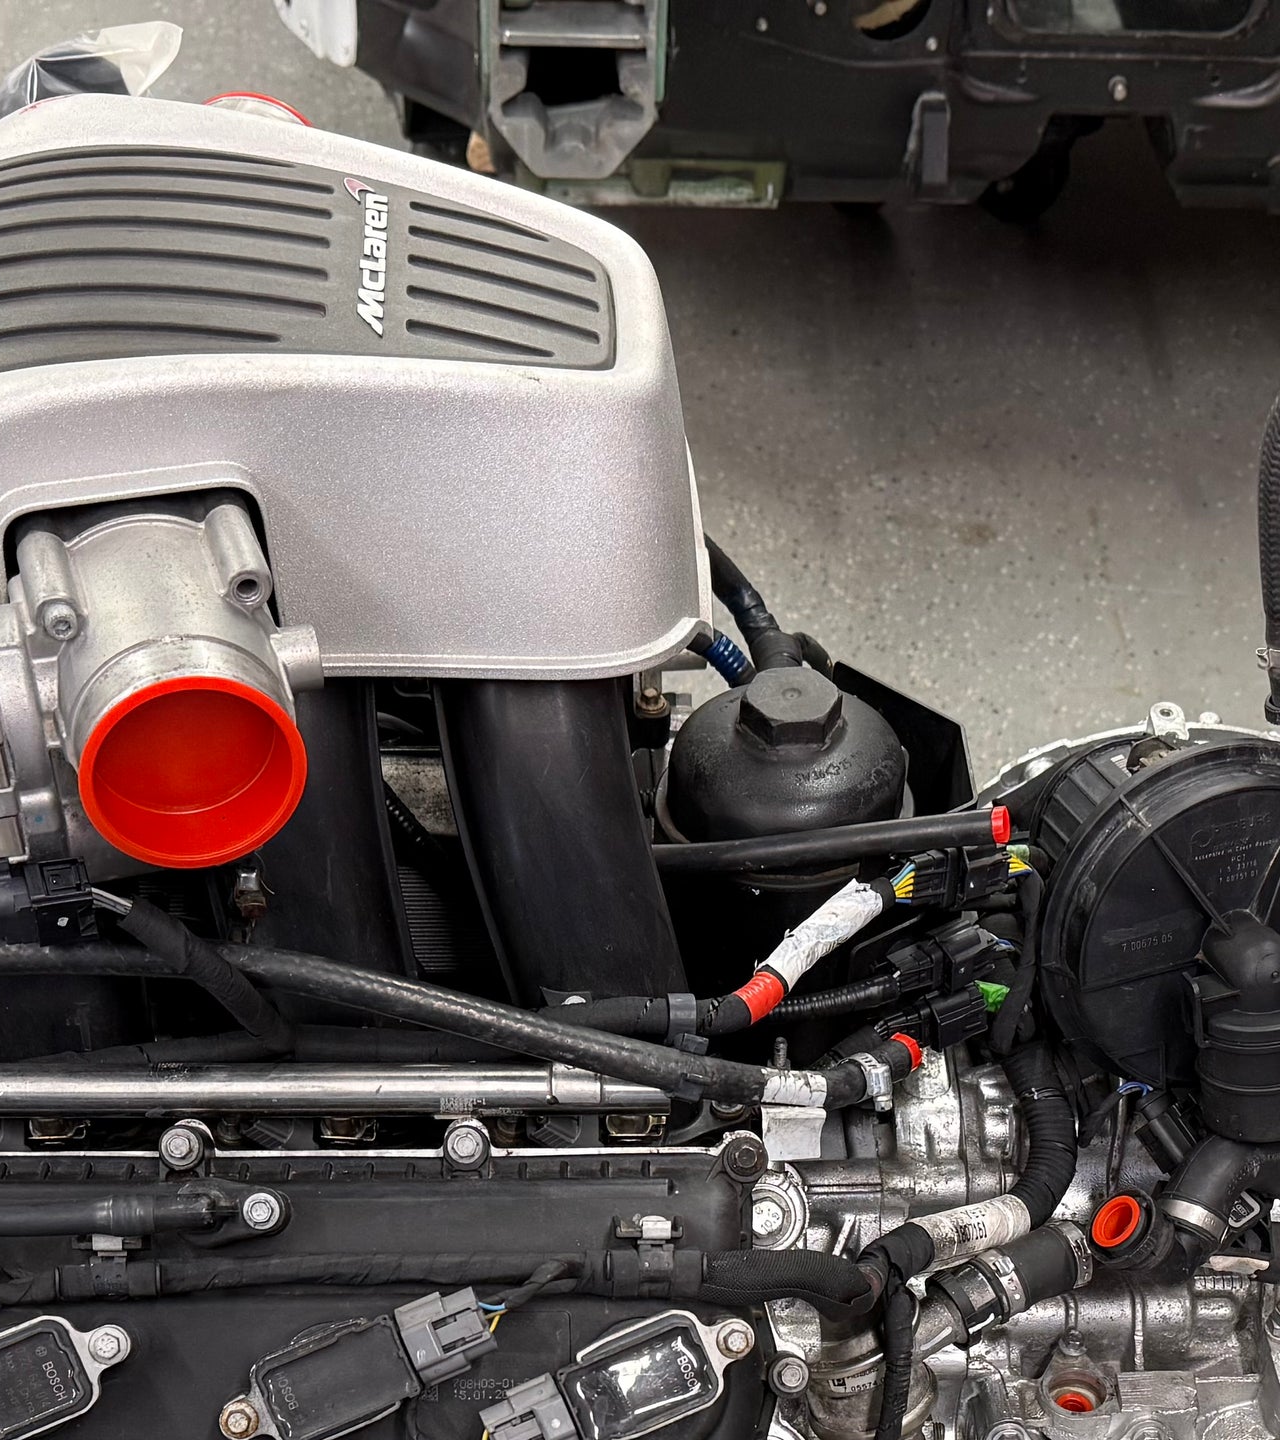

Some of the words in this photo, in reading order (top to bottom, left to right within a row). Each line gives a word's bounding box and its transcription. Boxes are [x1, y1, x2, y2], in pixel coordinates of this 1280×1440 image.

[357, 193, 390, 337] McLaren
[42, 1361, 68, 1402] BOSCH
[274, 1370, 300, 1411] BOSCH
